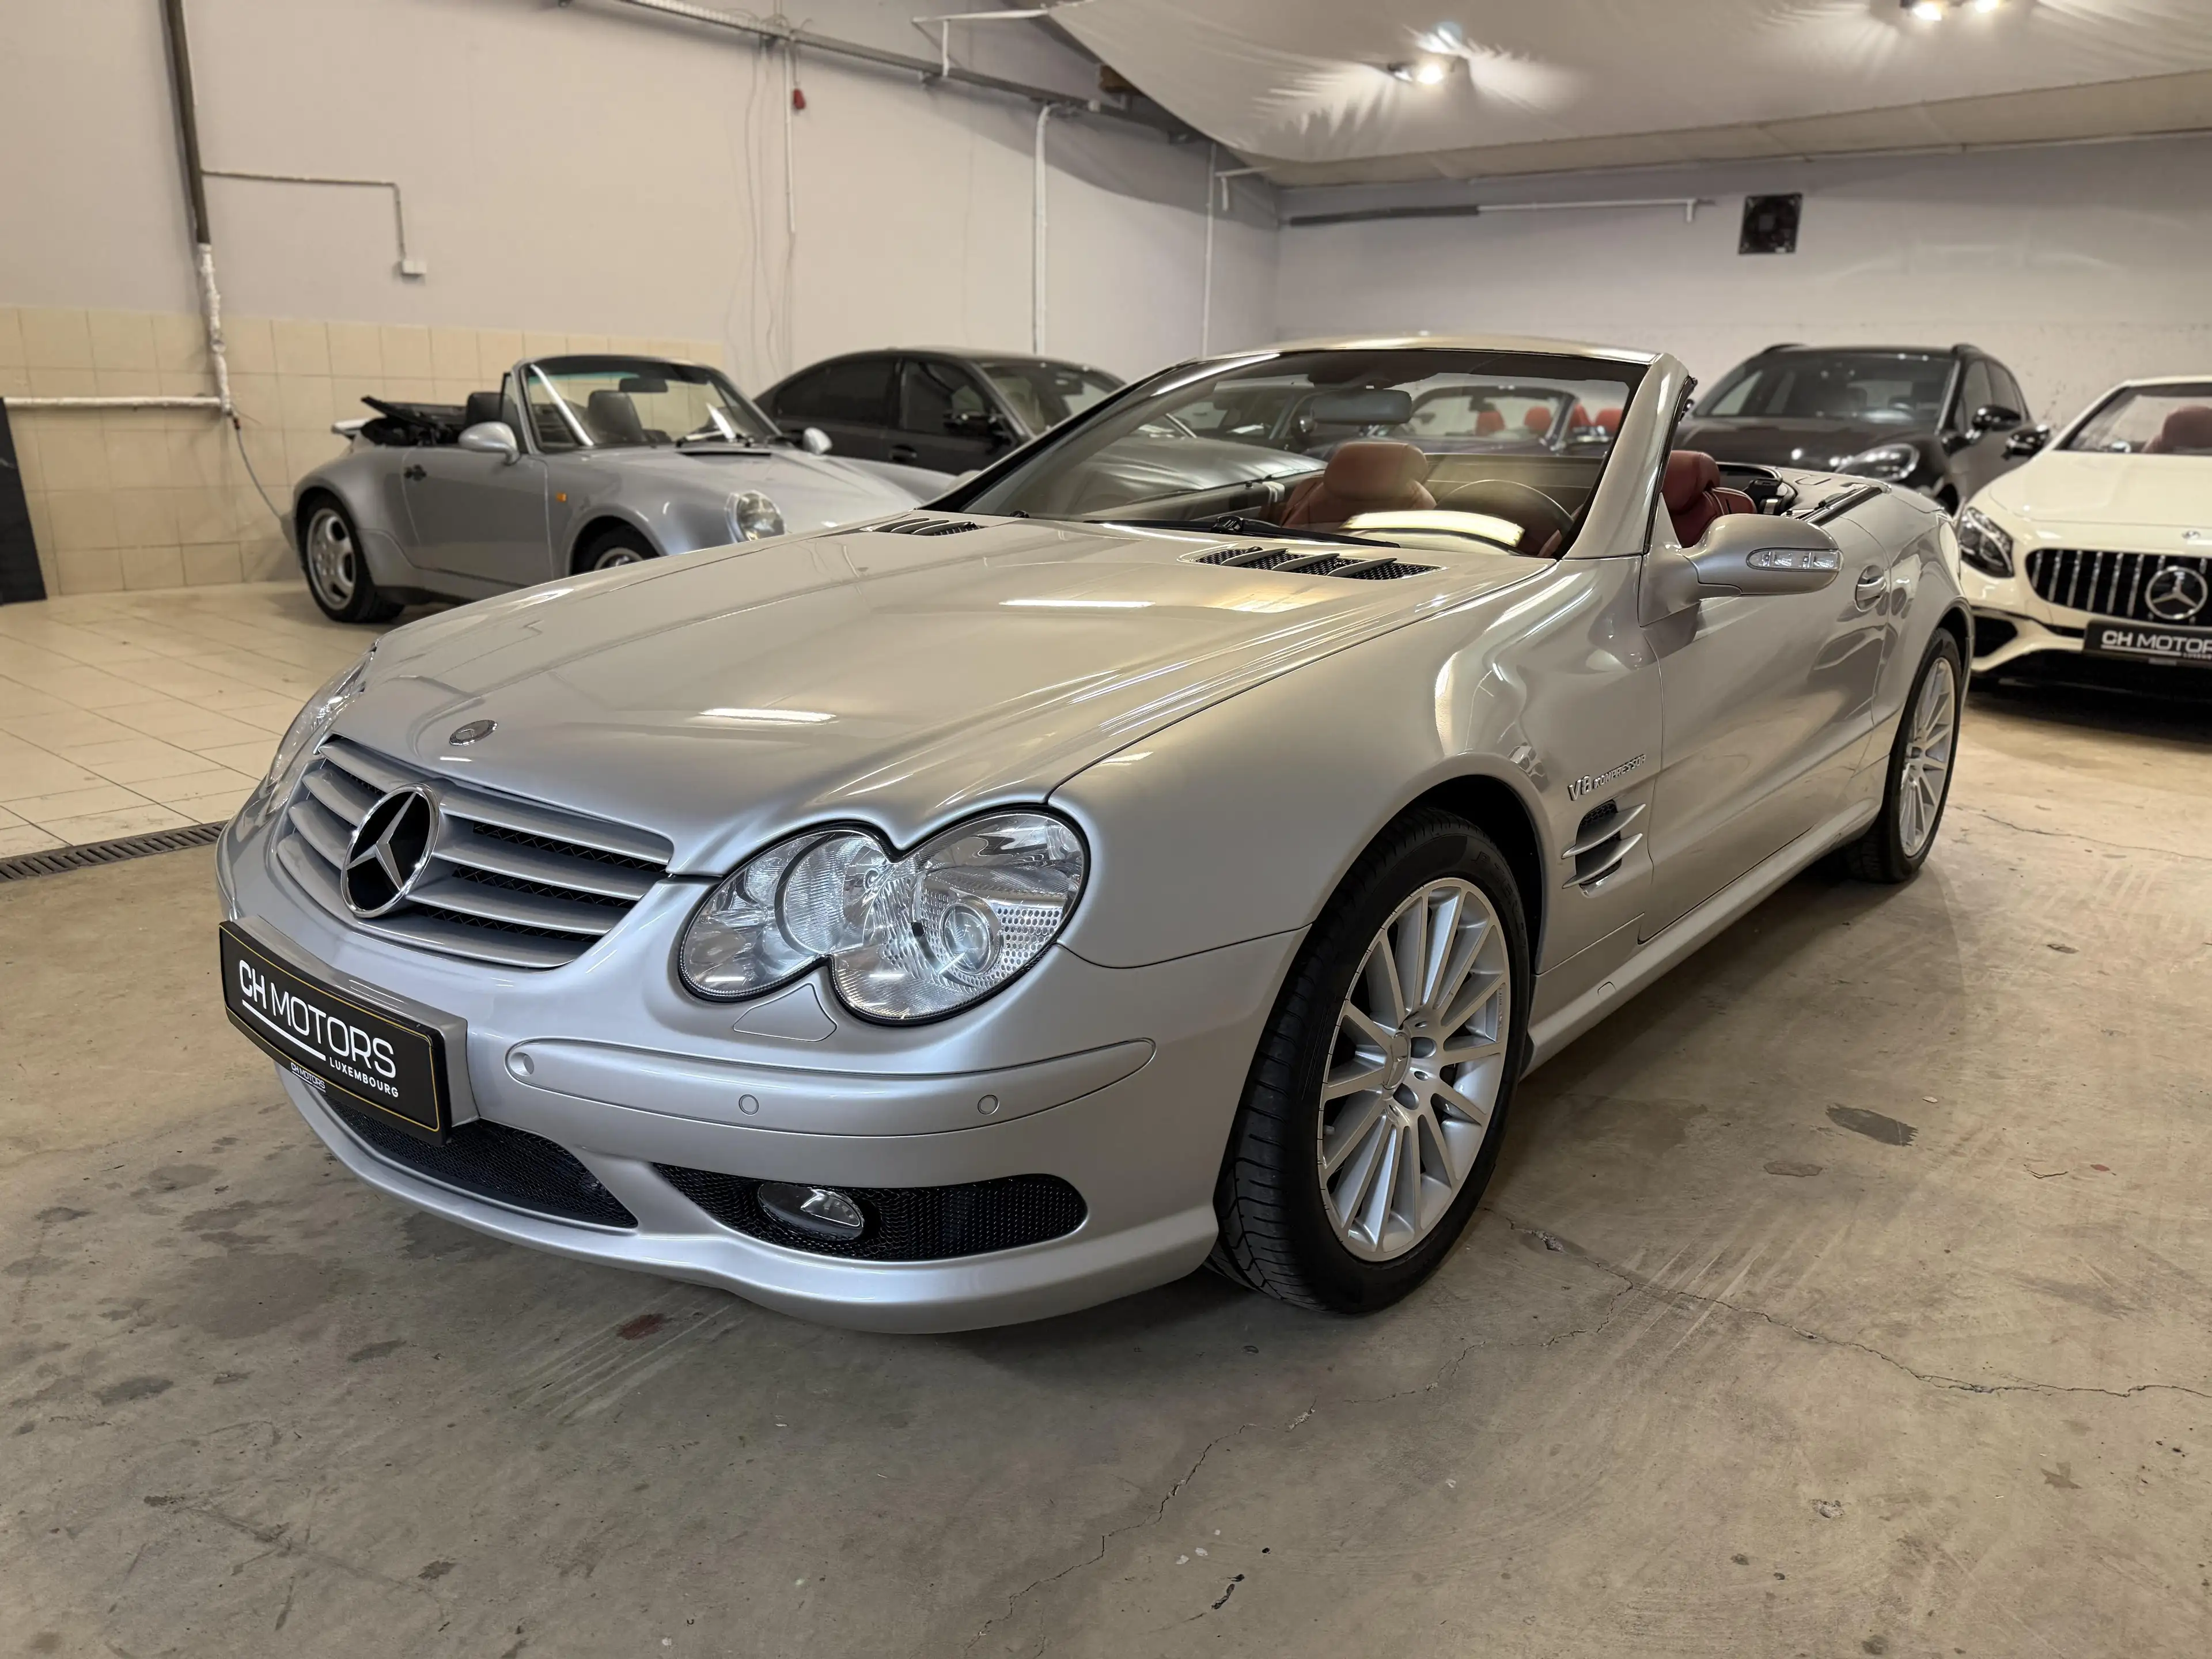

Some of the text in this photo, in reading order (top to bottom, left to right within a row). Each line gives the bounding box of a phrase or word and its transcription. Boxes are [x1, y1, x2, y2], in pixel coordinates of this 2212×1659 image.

[2102, 630, 2134, 647] CH
[1568, 753, 1646, 801] V8 KOMPRESSOR
[239, 960, 396, 1078] CH MOTORS
[290, 1062, 300, 1074] CH
[300, 1067, 325, 1089] MOTORS
[329, 1056, 399, 1097] LUXEMBOURG
